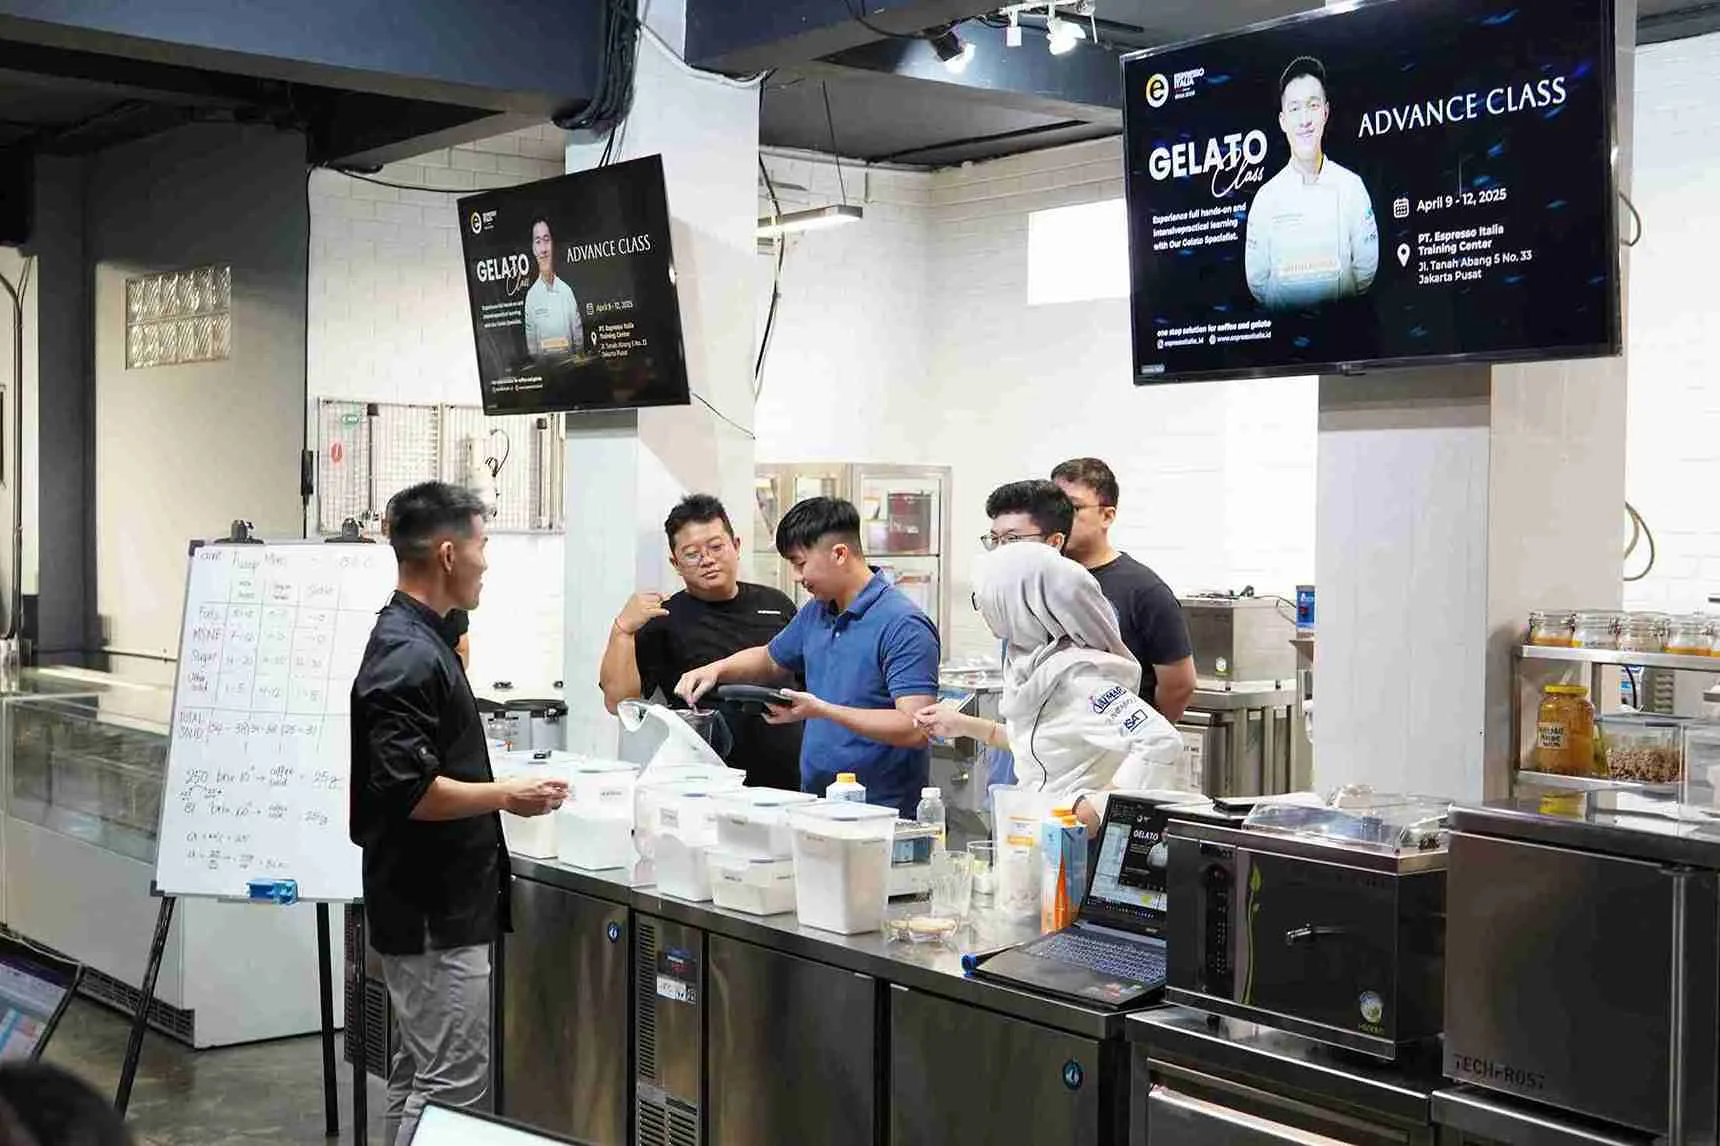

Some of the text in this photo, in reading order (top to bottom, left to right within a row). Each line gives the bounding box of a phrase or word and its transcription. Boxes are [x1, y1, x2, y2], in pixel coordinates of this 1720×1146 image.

[1358, 76, 1567, 138] ADVANCE CLASS
[1149, 129, 1268, 181] GELATO
[1211, 148, 1265, 198] Class
[1417, 196, 1443, 213] April
[1445, 196, 1453, 207] 9
[1463, 193, 1476, 205] 12,
[1479, 188, 1507, 202] 2025
[1152, 202, 1247, 224] Experience full hands-on and
[1210, 218, 1238, 229] learning
[1418, 224, 1504, 243] PT. Espresso Italia
[567, 234, 651, 263] ADVANCE CLASS
[1153, 242, 1168, 250] with
[1169, 240, 1182, 248] Our
[1418, 240, 1492, 256] Training Center
[477, 254, 529, 282] GELATO
[1430, 259, 1458, 270] Tanah
[1461, 255, 1491, 267] Abang
[1502, 252, 1519, 262] No.
[1520, 250, 1532, 261] 33
[1418, 270, 1482, 285] Jakarta Pusat
[1133, 829, 1159, 841] GELATO
